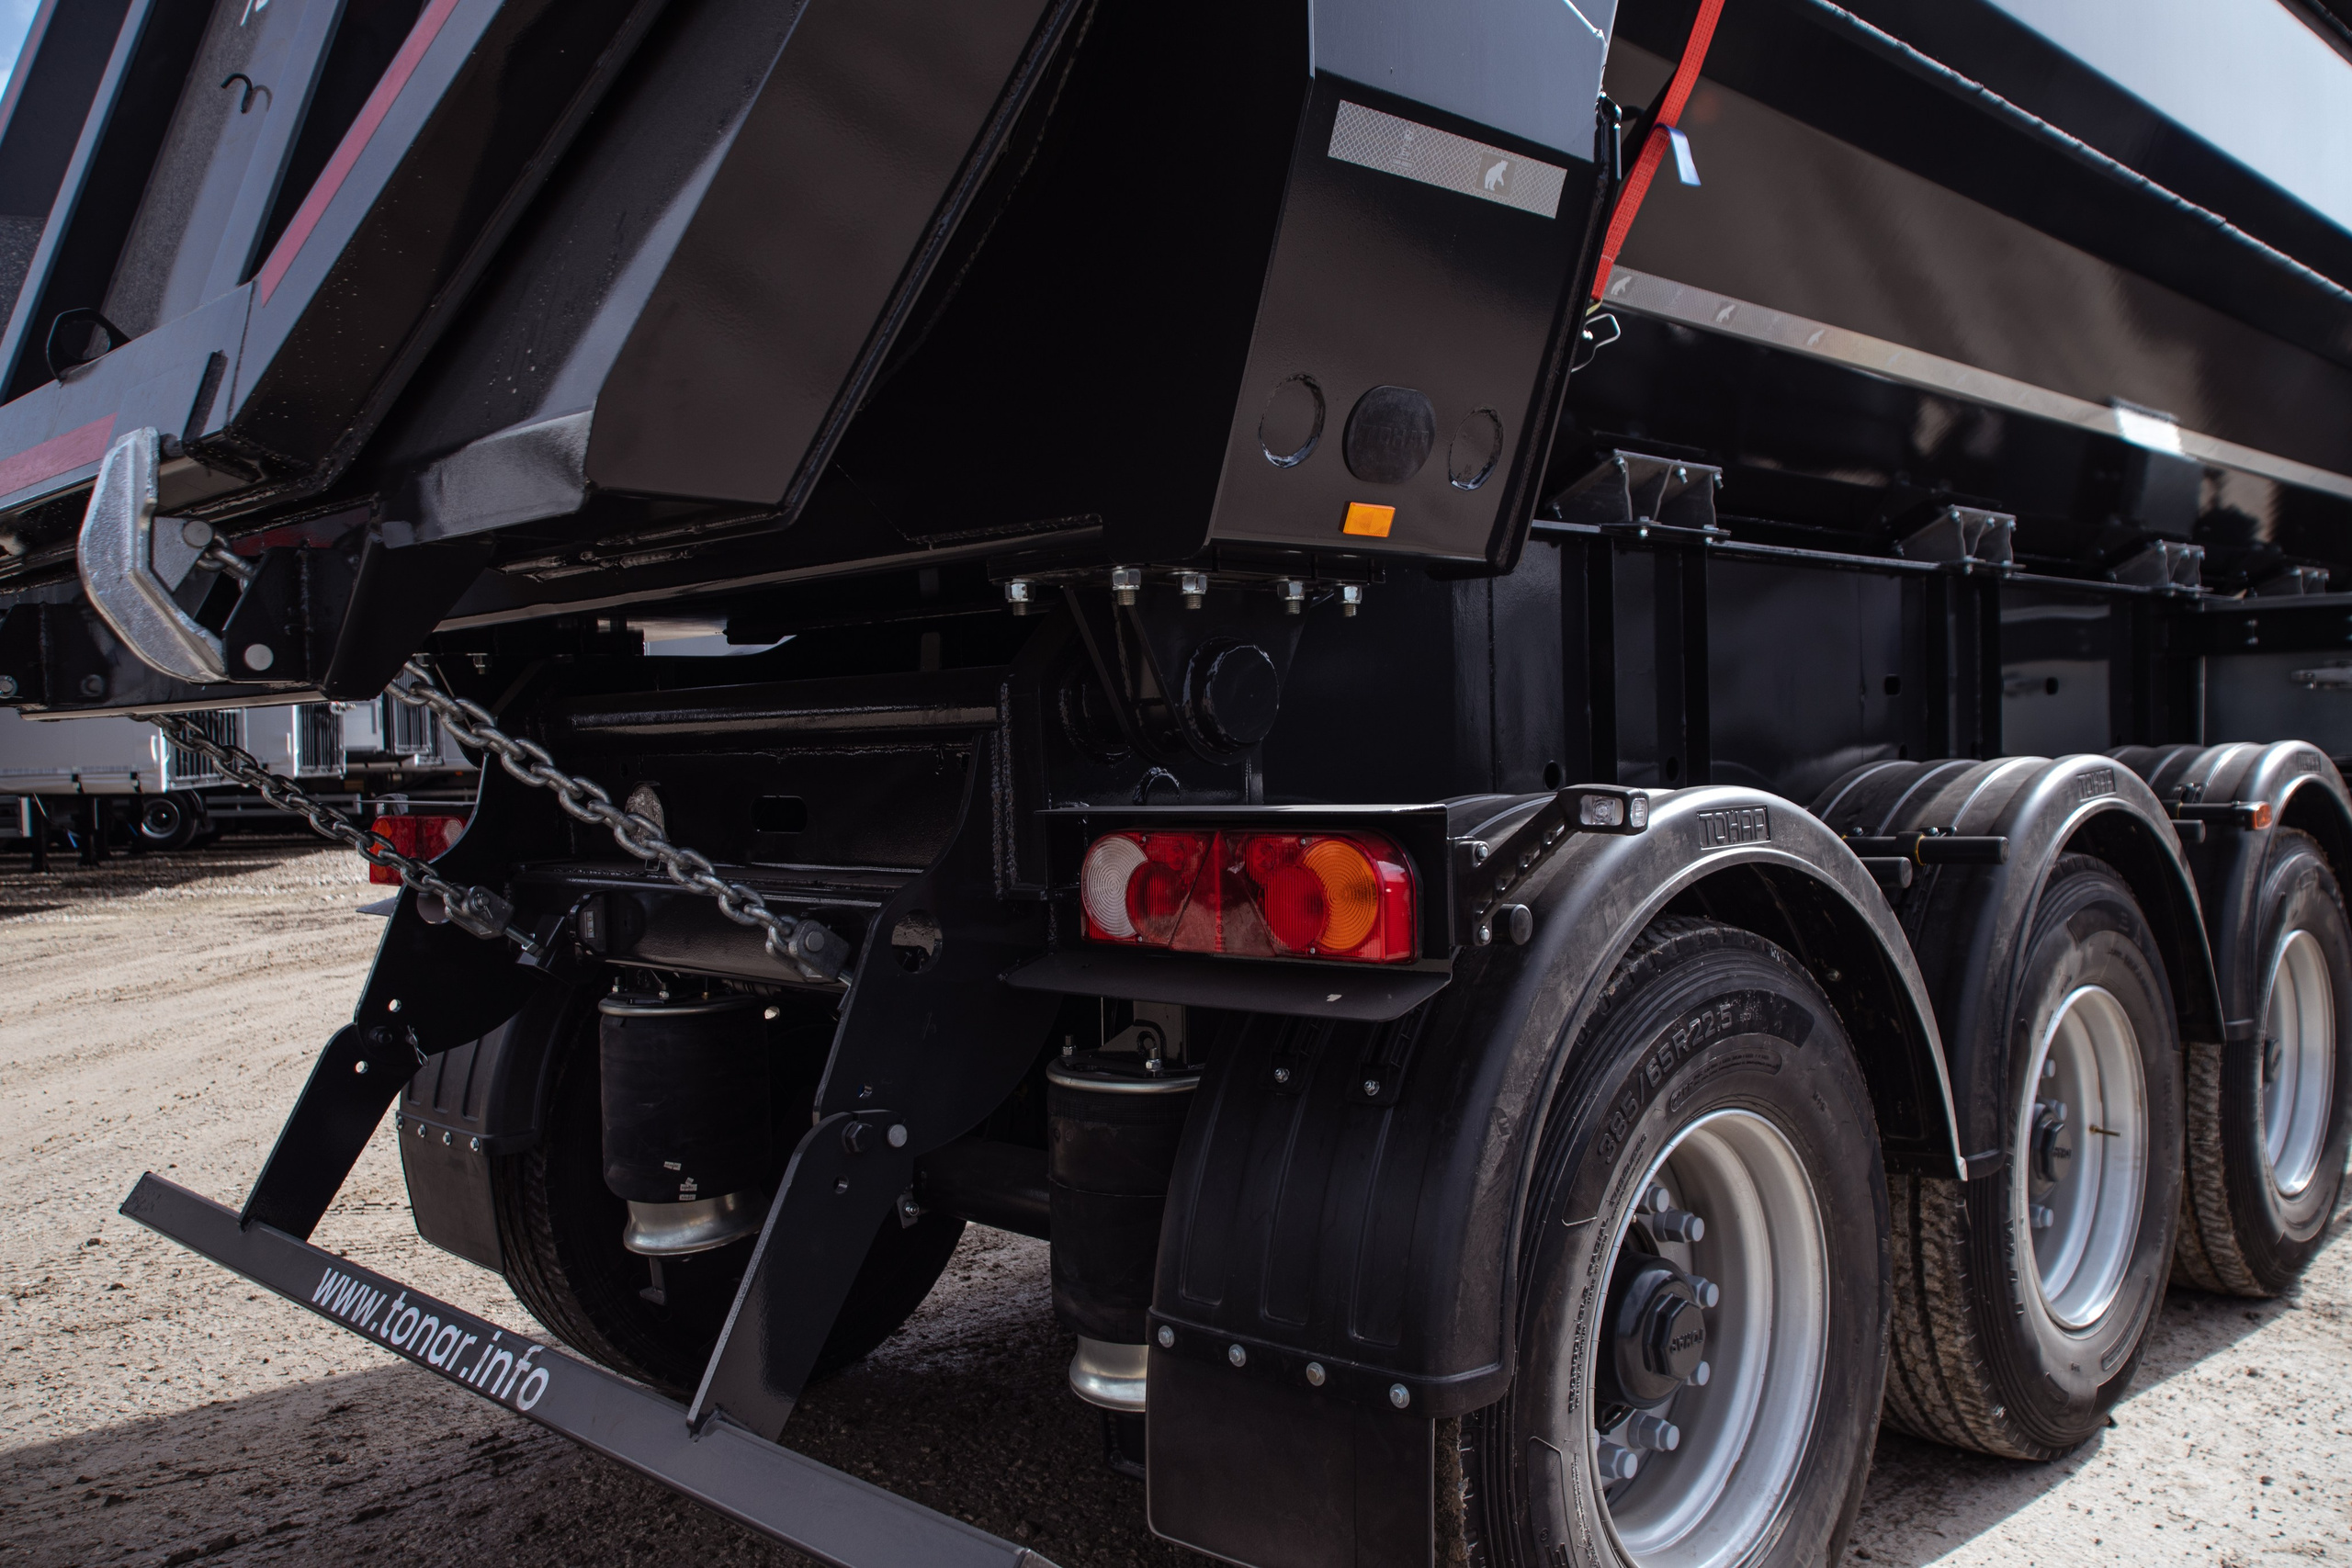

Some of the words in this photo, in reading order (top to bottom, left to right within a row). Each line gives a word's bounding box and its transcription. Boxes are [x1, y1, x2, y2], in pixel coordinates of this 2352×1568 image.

[1699, 808, 1764, 846] ТОНАР
[1598, 1003, 1733, 1165] 385/65R22.5
[1587, 1217, 1610, 1277] RADIAL
[311, 1267, 550, 1412] www.tonar.info
